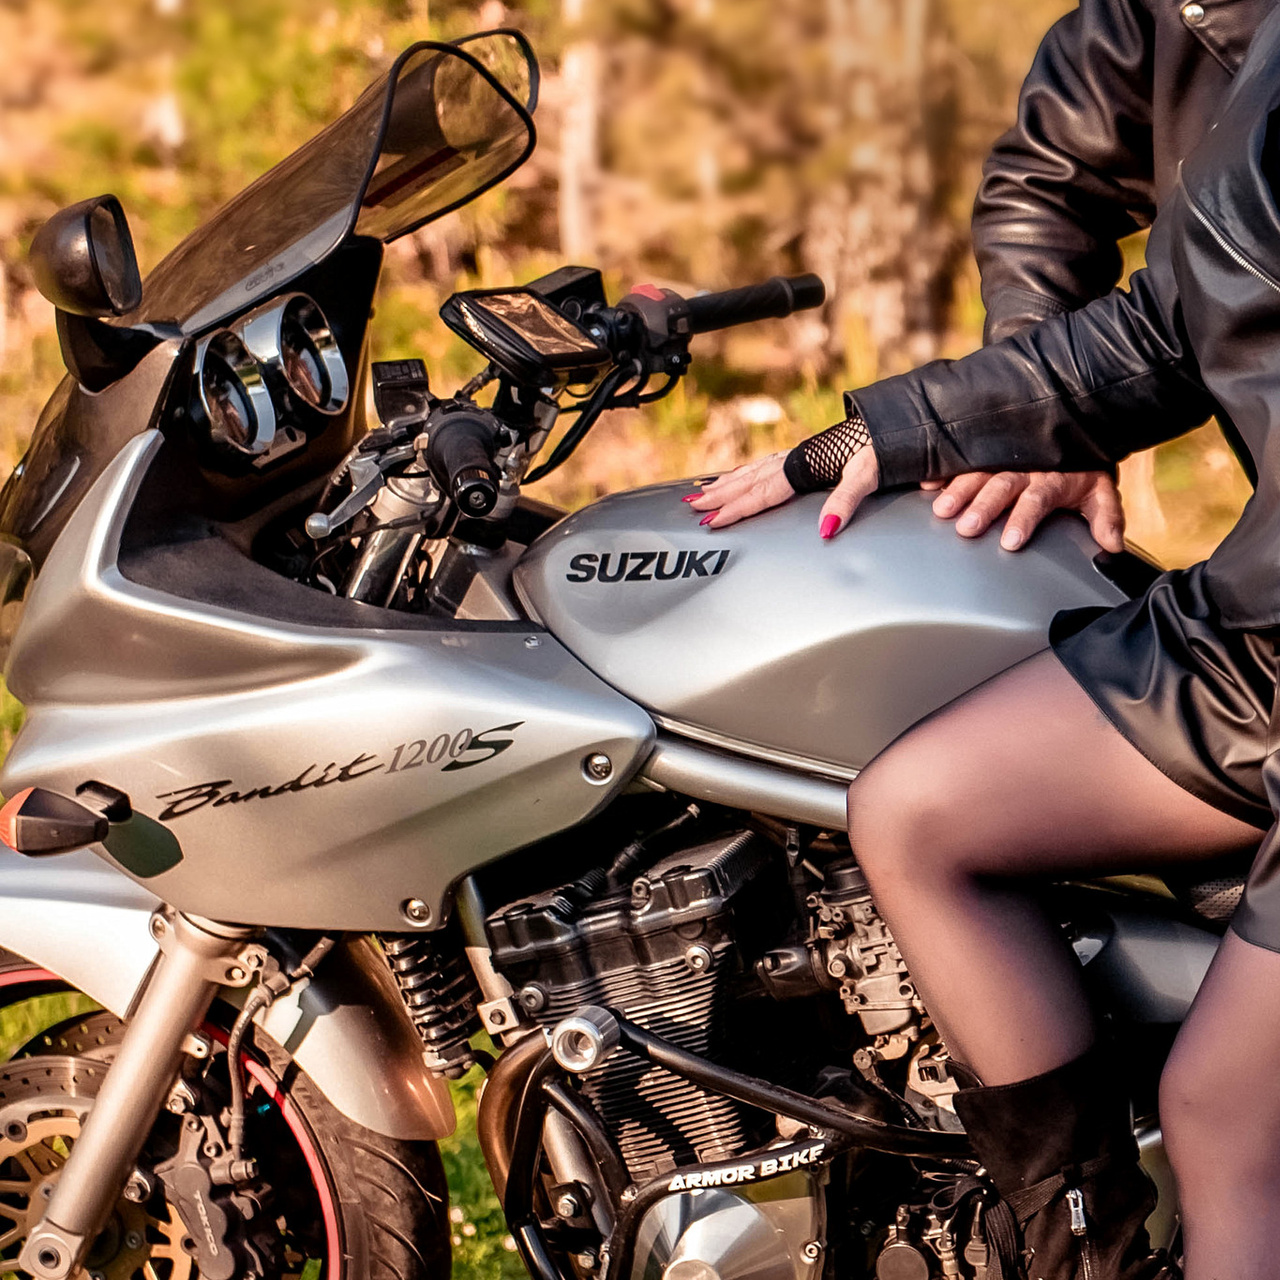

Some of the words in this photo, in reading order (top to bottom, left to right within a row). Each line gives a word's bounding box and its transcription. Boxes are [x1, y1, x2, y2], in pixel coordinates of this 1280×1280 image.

[566, 549, 731, 583] SUZUKI
[155, 753, 385, 821] Bandit
[384, 721, 526, 773] 1200S
[668, 1164, 756, 1192] ARMOR
